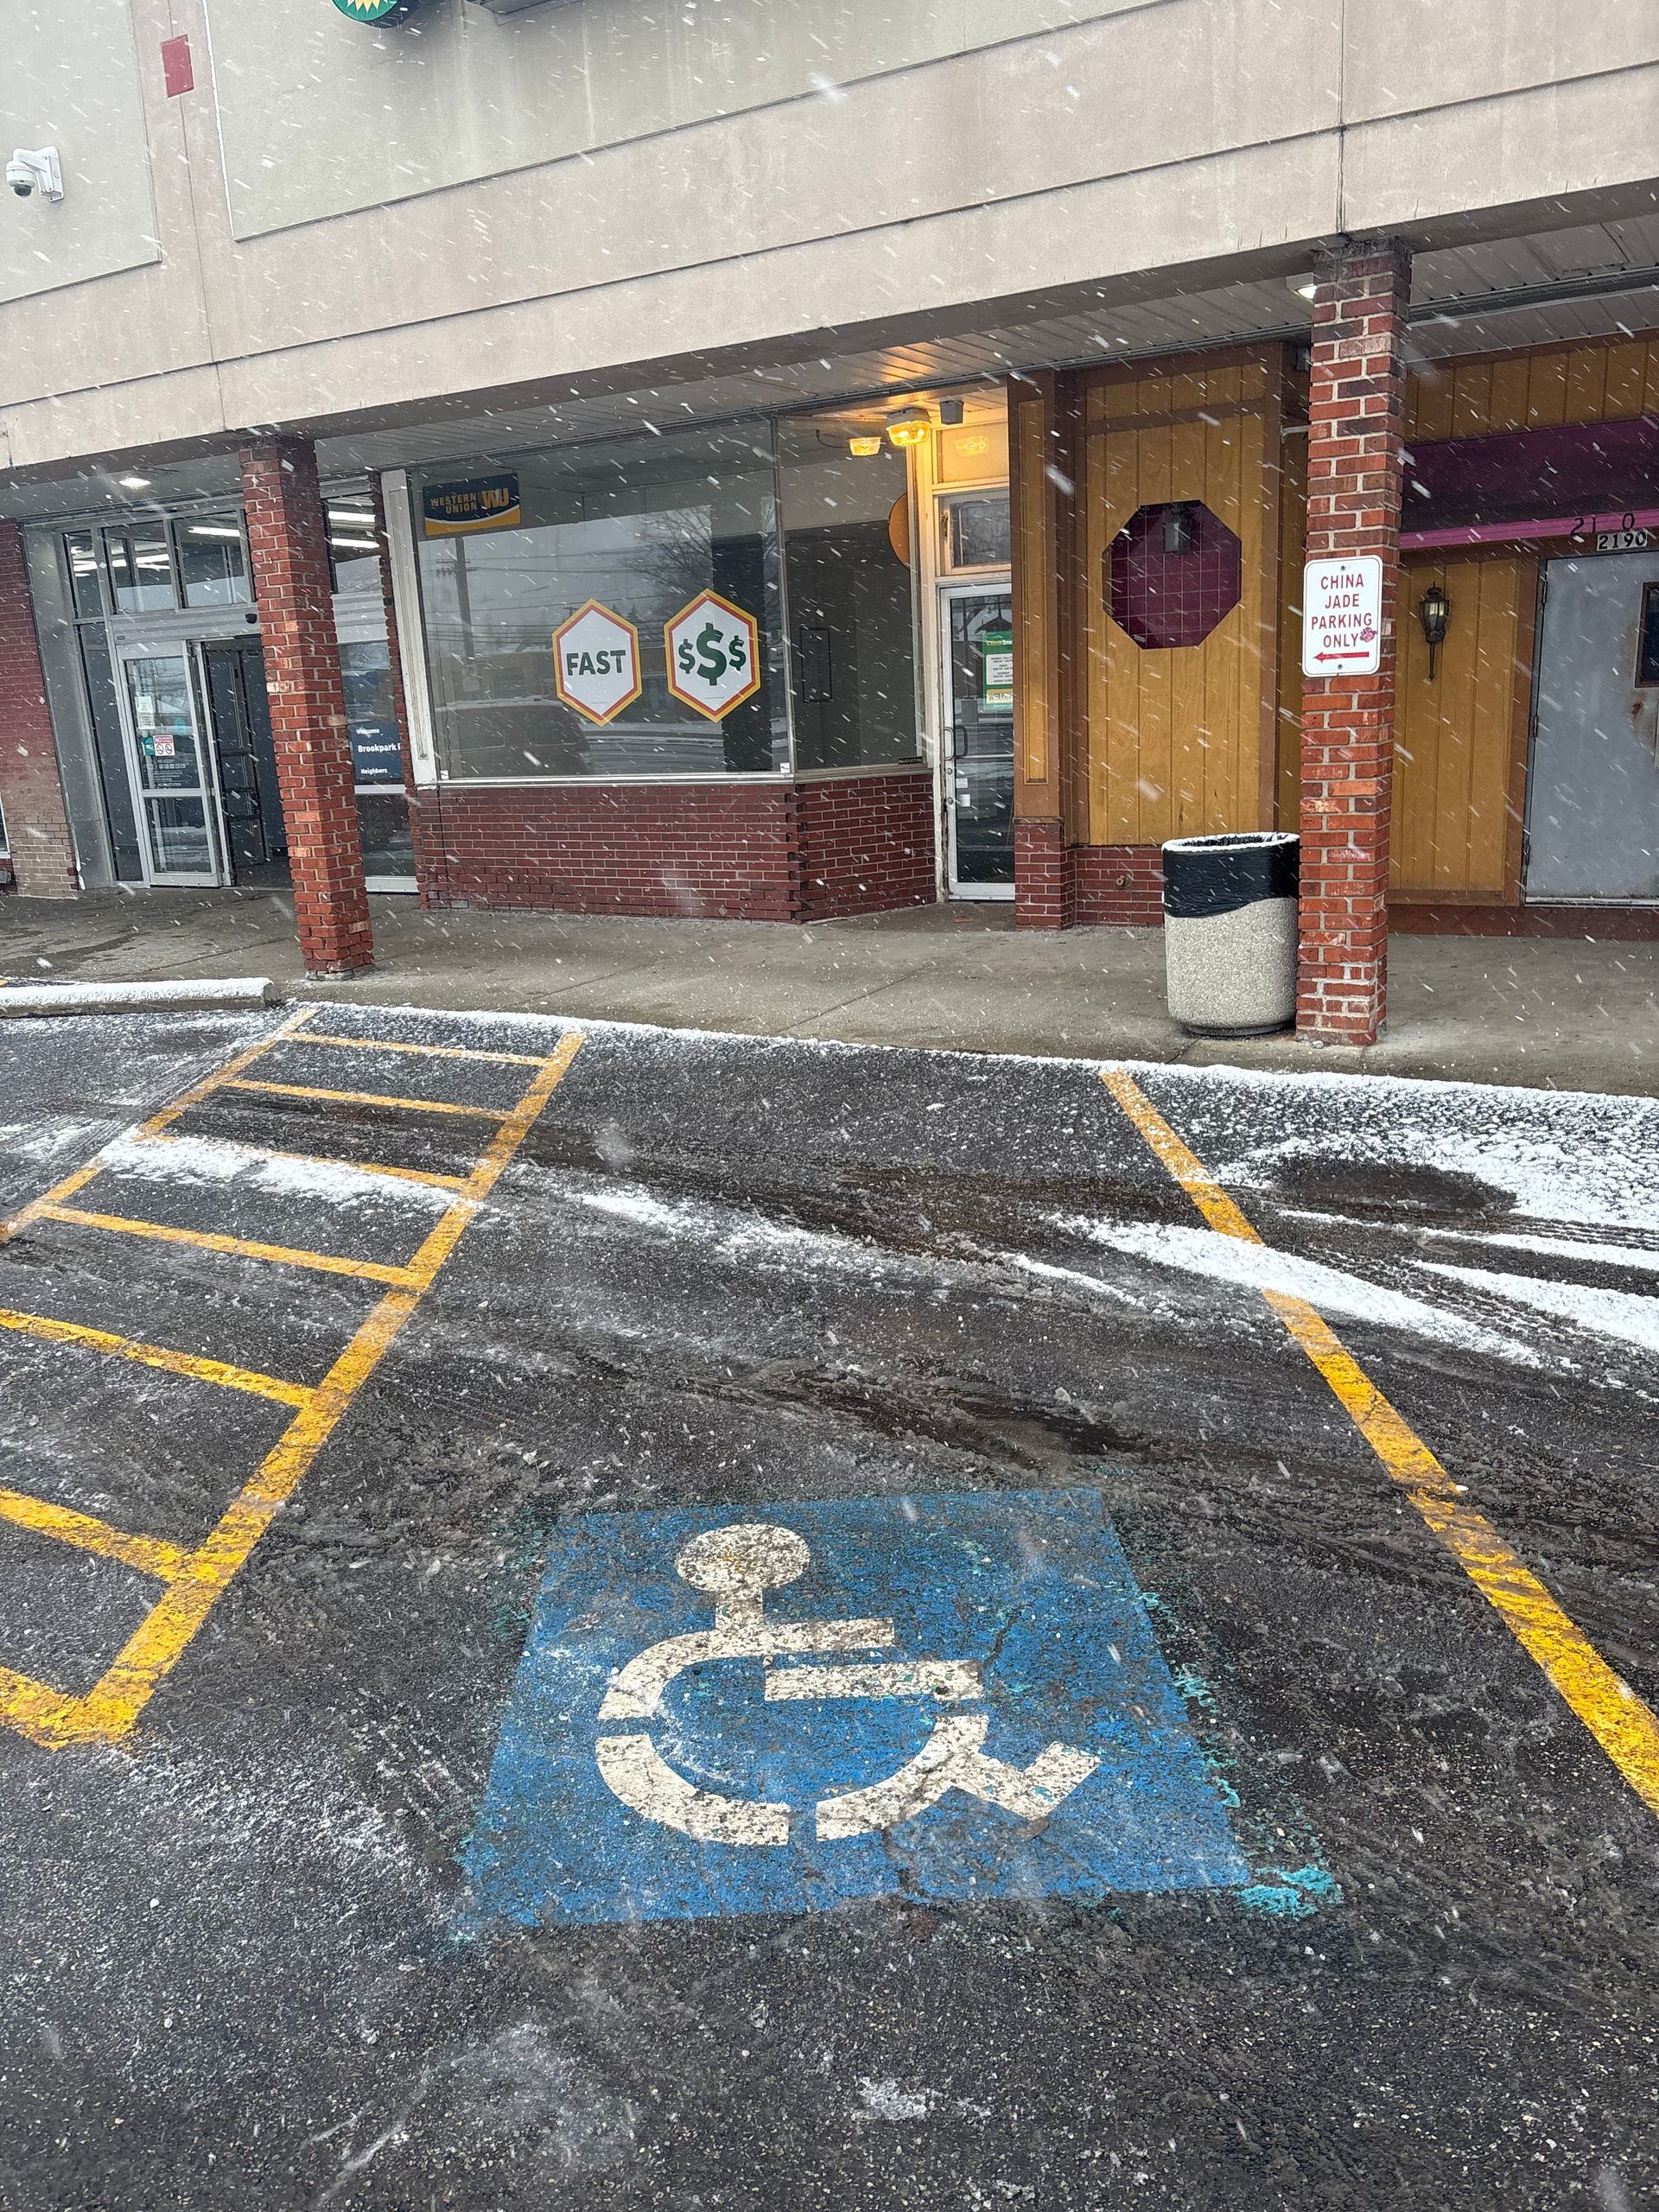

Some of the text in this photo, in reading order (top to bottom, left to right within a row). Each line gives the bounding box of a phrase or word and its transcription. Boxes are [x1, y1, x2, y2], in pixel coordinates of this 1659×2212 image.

[429, 492, 477, 507] WESTERN
[481, 487, 510, 509] WU
[445, 501, 478, 514] UNION
[1598, 531, 1647, 550] 2190
[1320, 574, 1364, 589] CHINA
[1325, 593, 1360, 609] JADE
[1311, 612, 1372, 630] PARKING
[1323, 632, 1359, 648] ONLY
[566, 649, 626, 677] FAST
[358, 743, 397, 753] Brookpark
